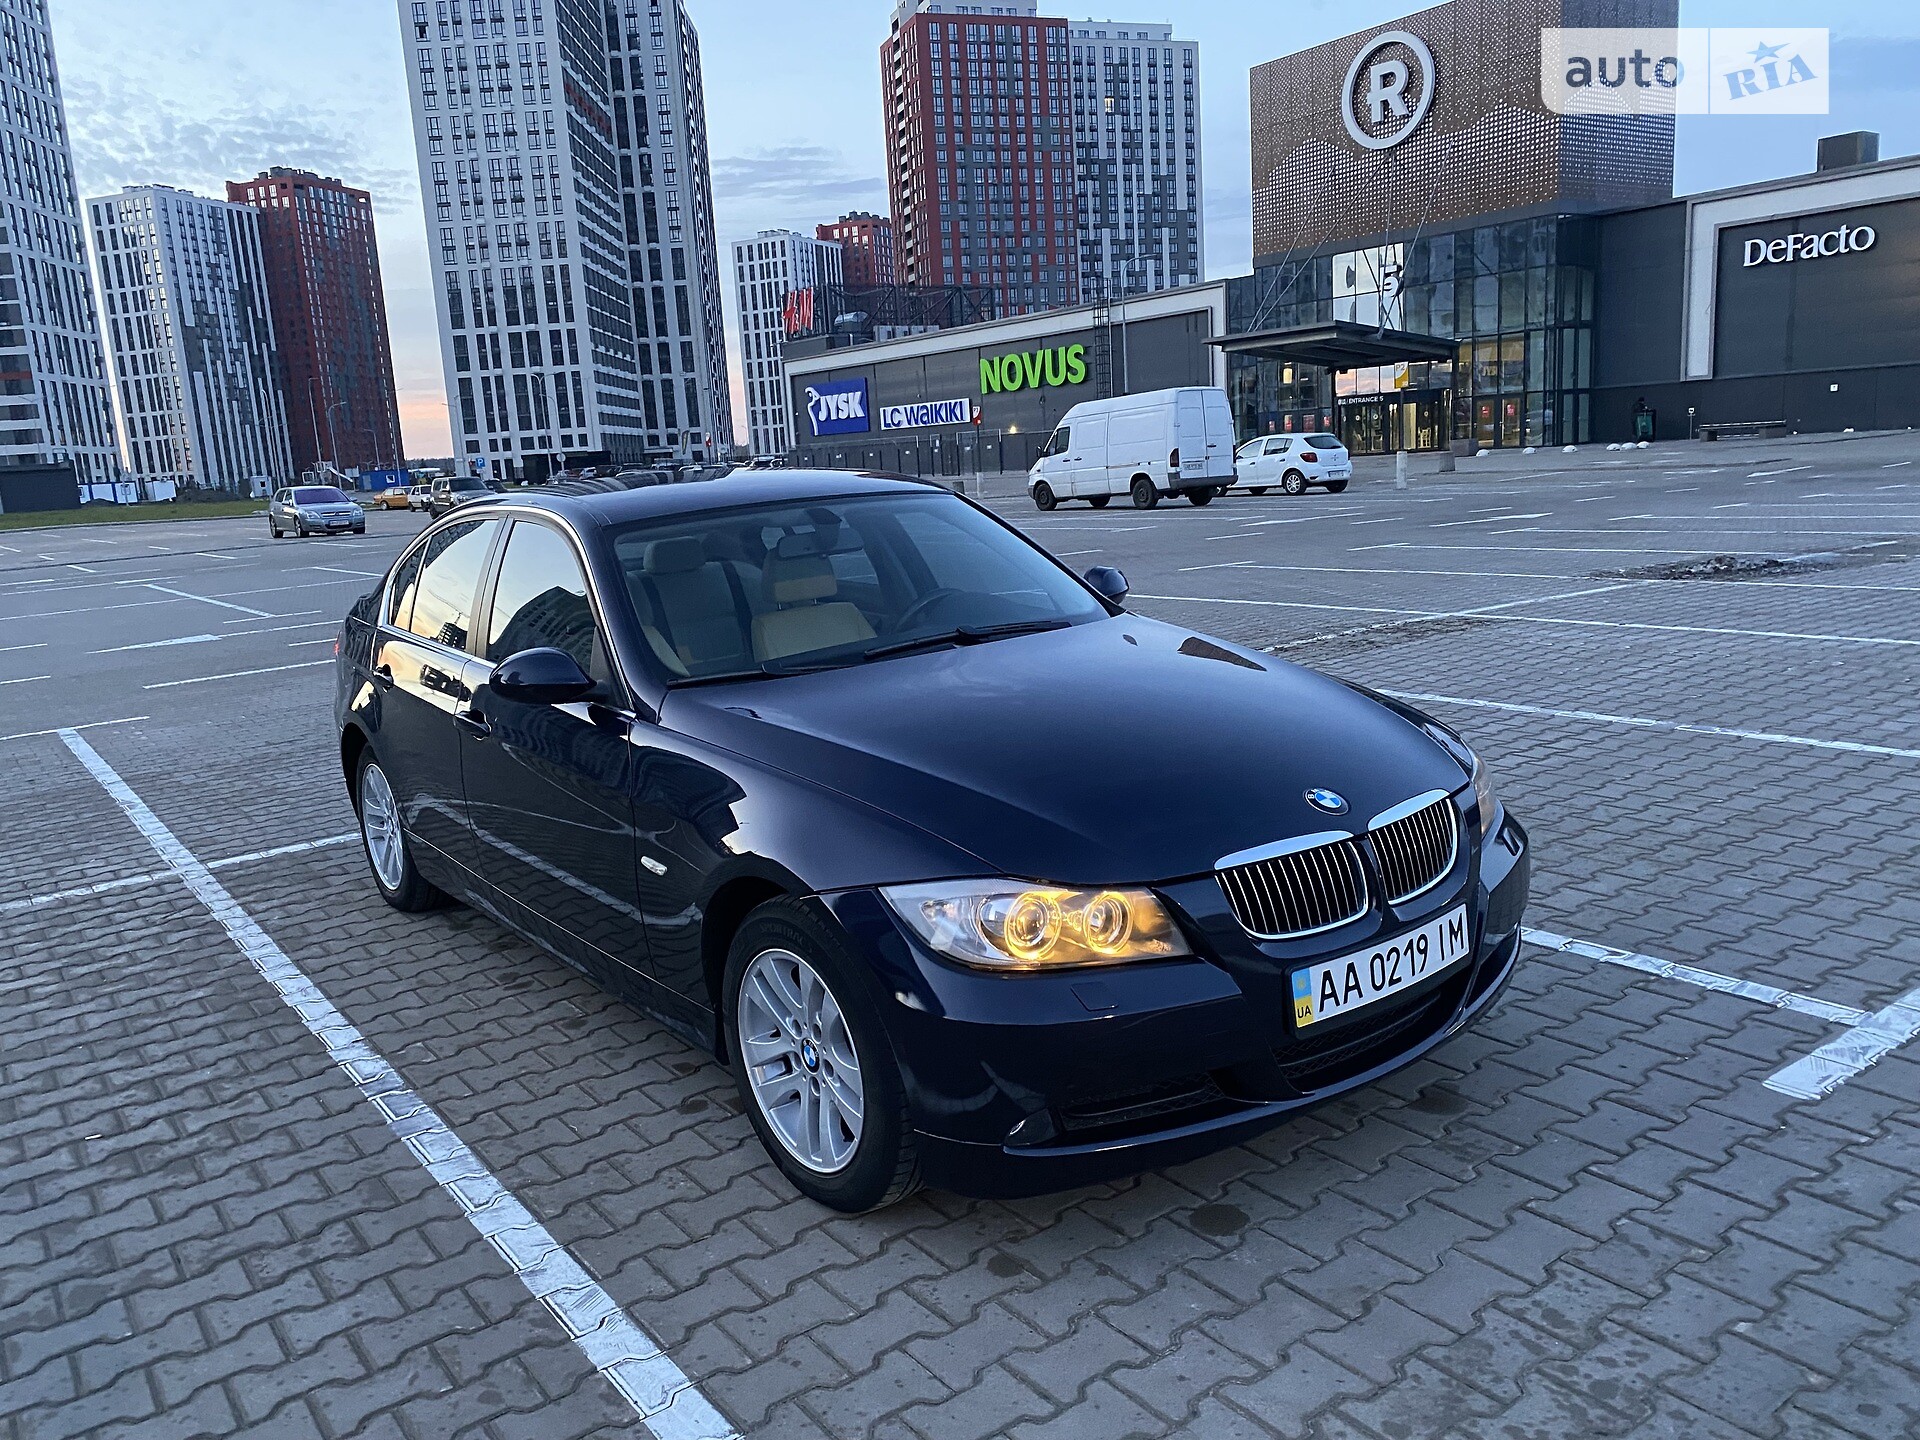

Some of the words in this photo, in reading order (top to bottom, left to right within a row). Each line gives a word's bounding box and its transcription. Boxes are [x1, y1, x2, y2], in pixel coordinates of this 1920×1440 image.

[1743, 224, 1876, 267] DeFacto
[979, 343, 1086, 395] NOVUS
[818, 391, 866, 422] JYSK
[1348, 396, 1379, 405] ENTRANCE
[882, 407, 901, 428] LC
[1319, 961, 1364, 1013] AA
[1369, 933, 1429, 992] 0219
[1438, 912, 1464, 962] IM
[1296, 1004, 1312, 1019] UA
